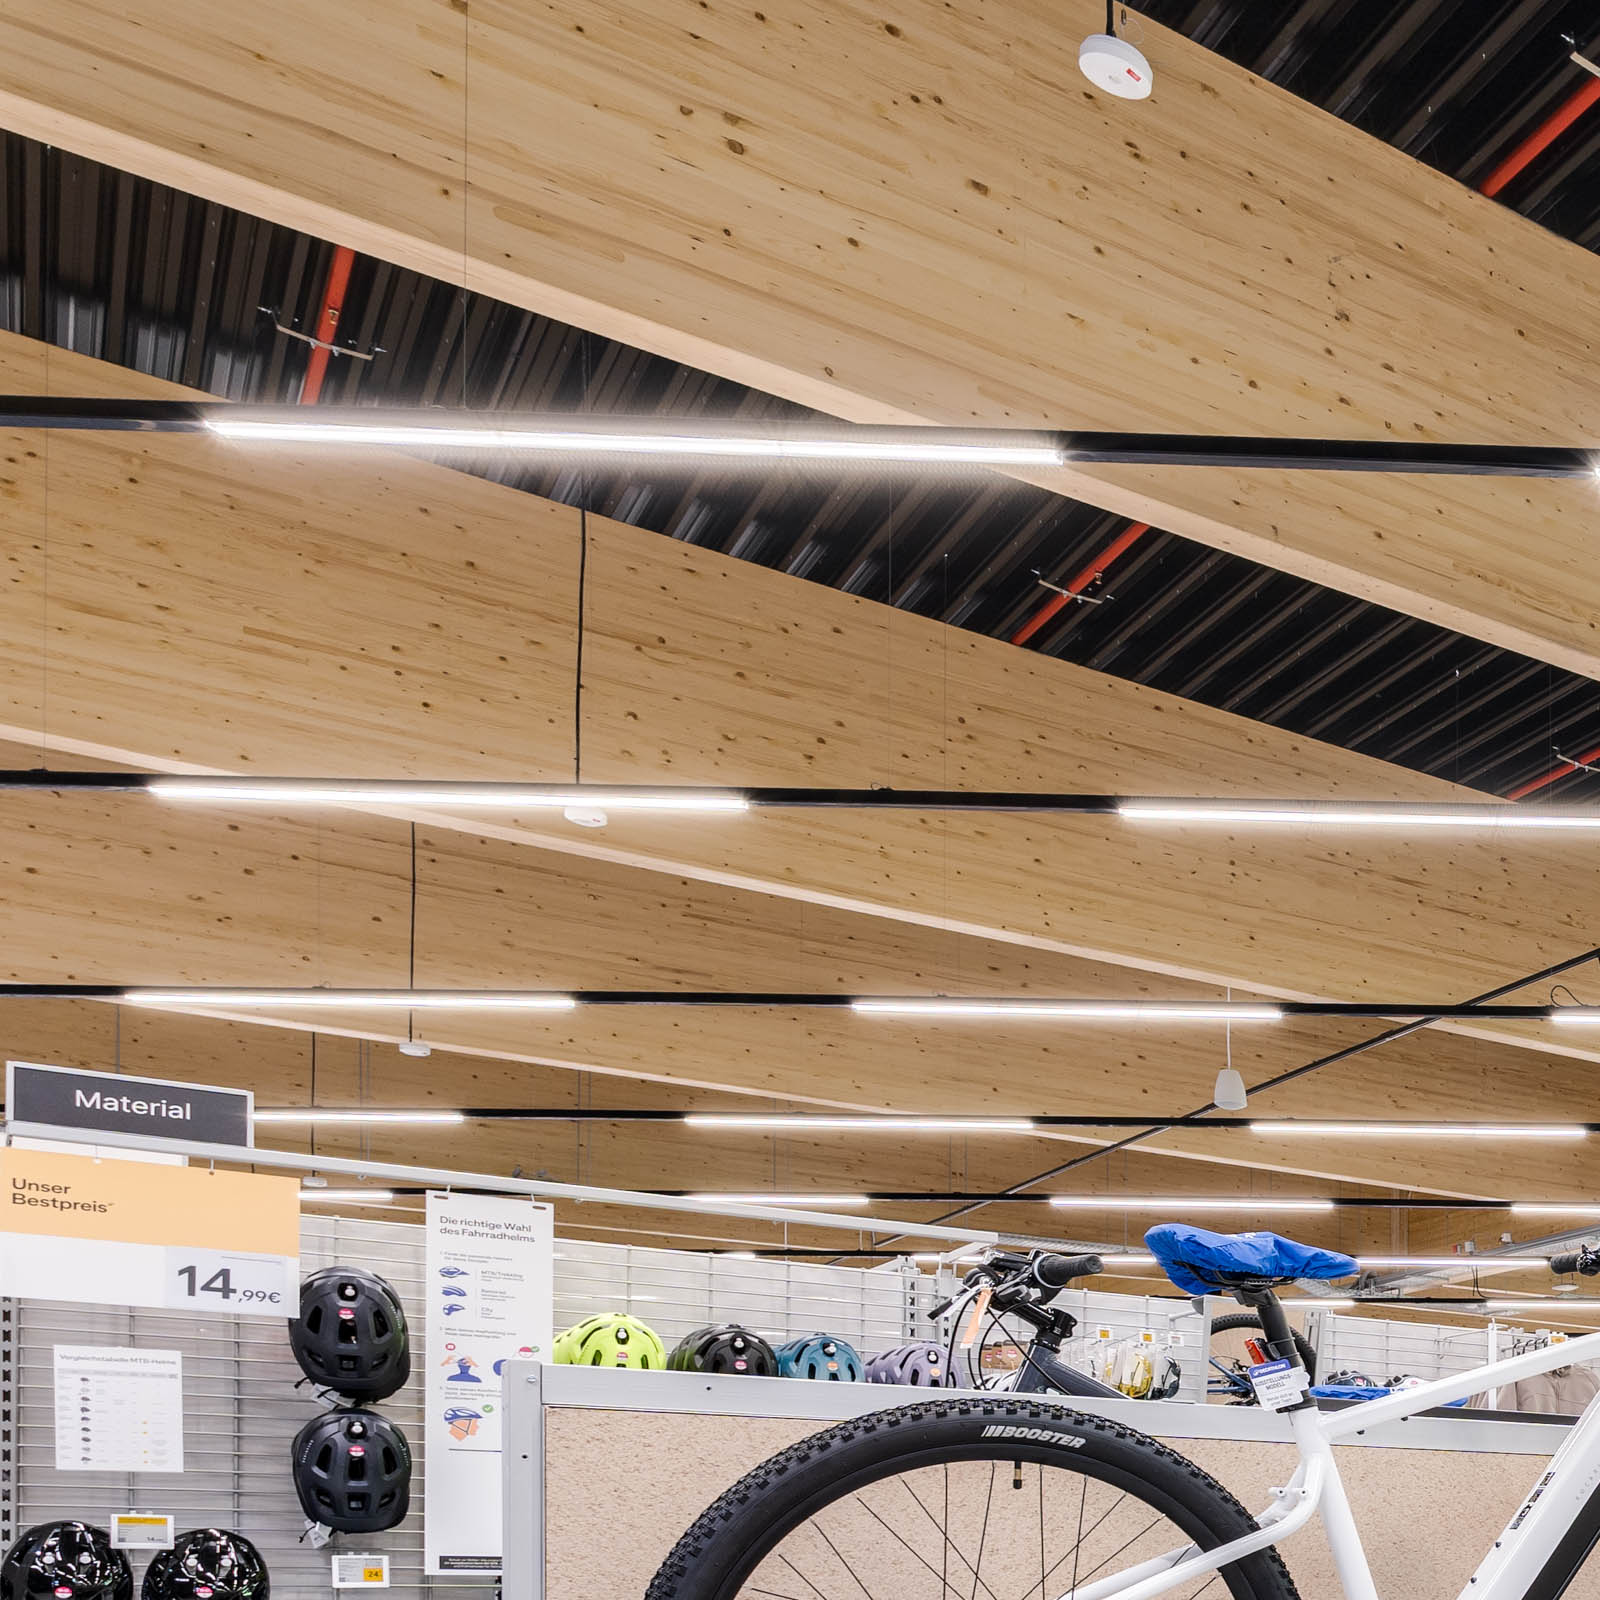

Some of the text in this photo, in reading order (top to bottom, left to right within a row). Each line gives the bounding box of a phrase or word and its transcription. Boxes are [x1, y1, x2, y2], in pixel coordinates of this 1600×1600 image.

[75, 1089, 192, 1121] Material
[12, 1177, 71, 1195] Unser
[12, 1192, 108, 1213] Bestpreis
[439, 1215, 532, 1233] Die richtige Wahl
[439, 1227, 535, 1243] des Fahrradhelms
[178, 1265, 281, 1304] 14,99€
[1000, 1425, 1087, 1449] BOOSTER
